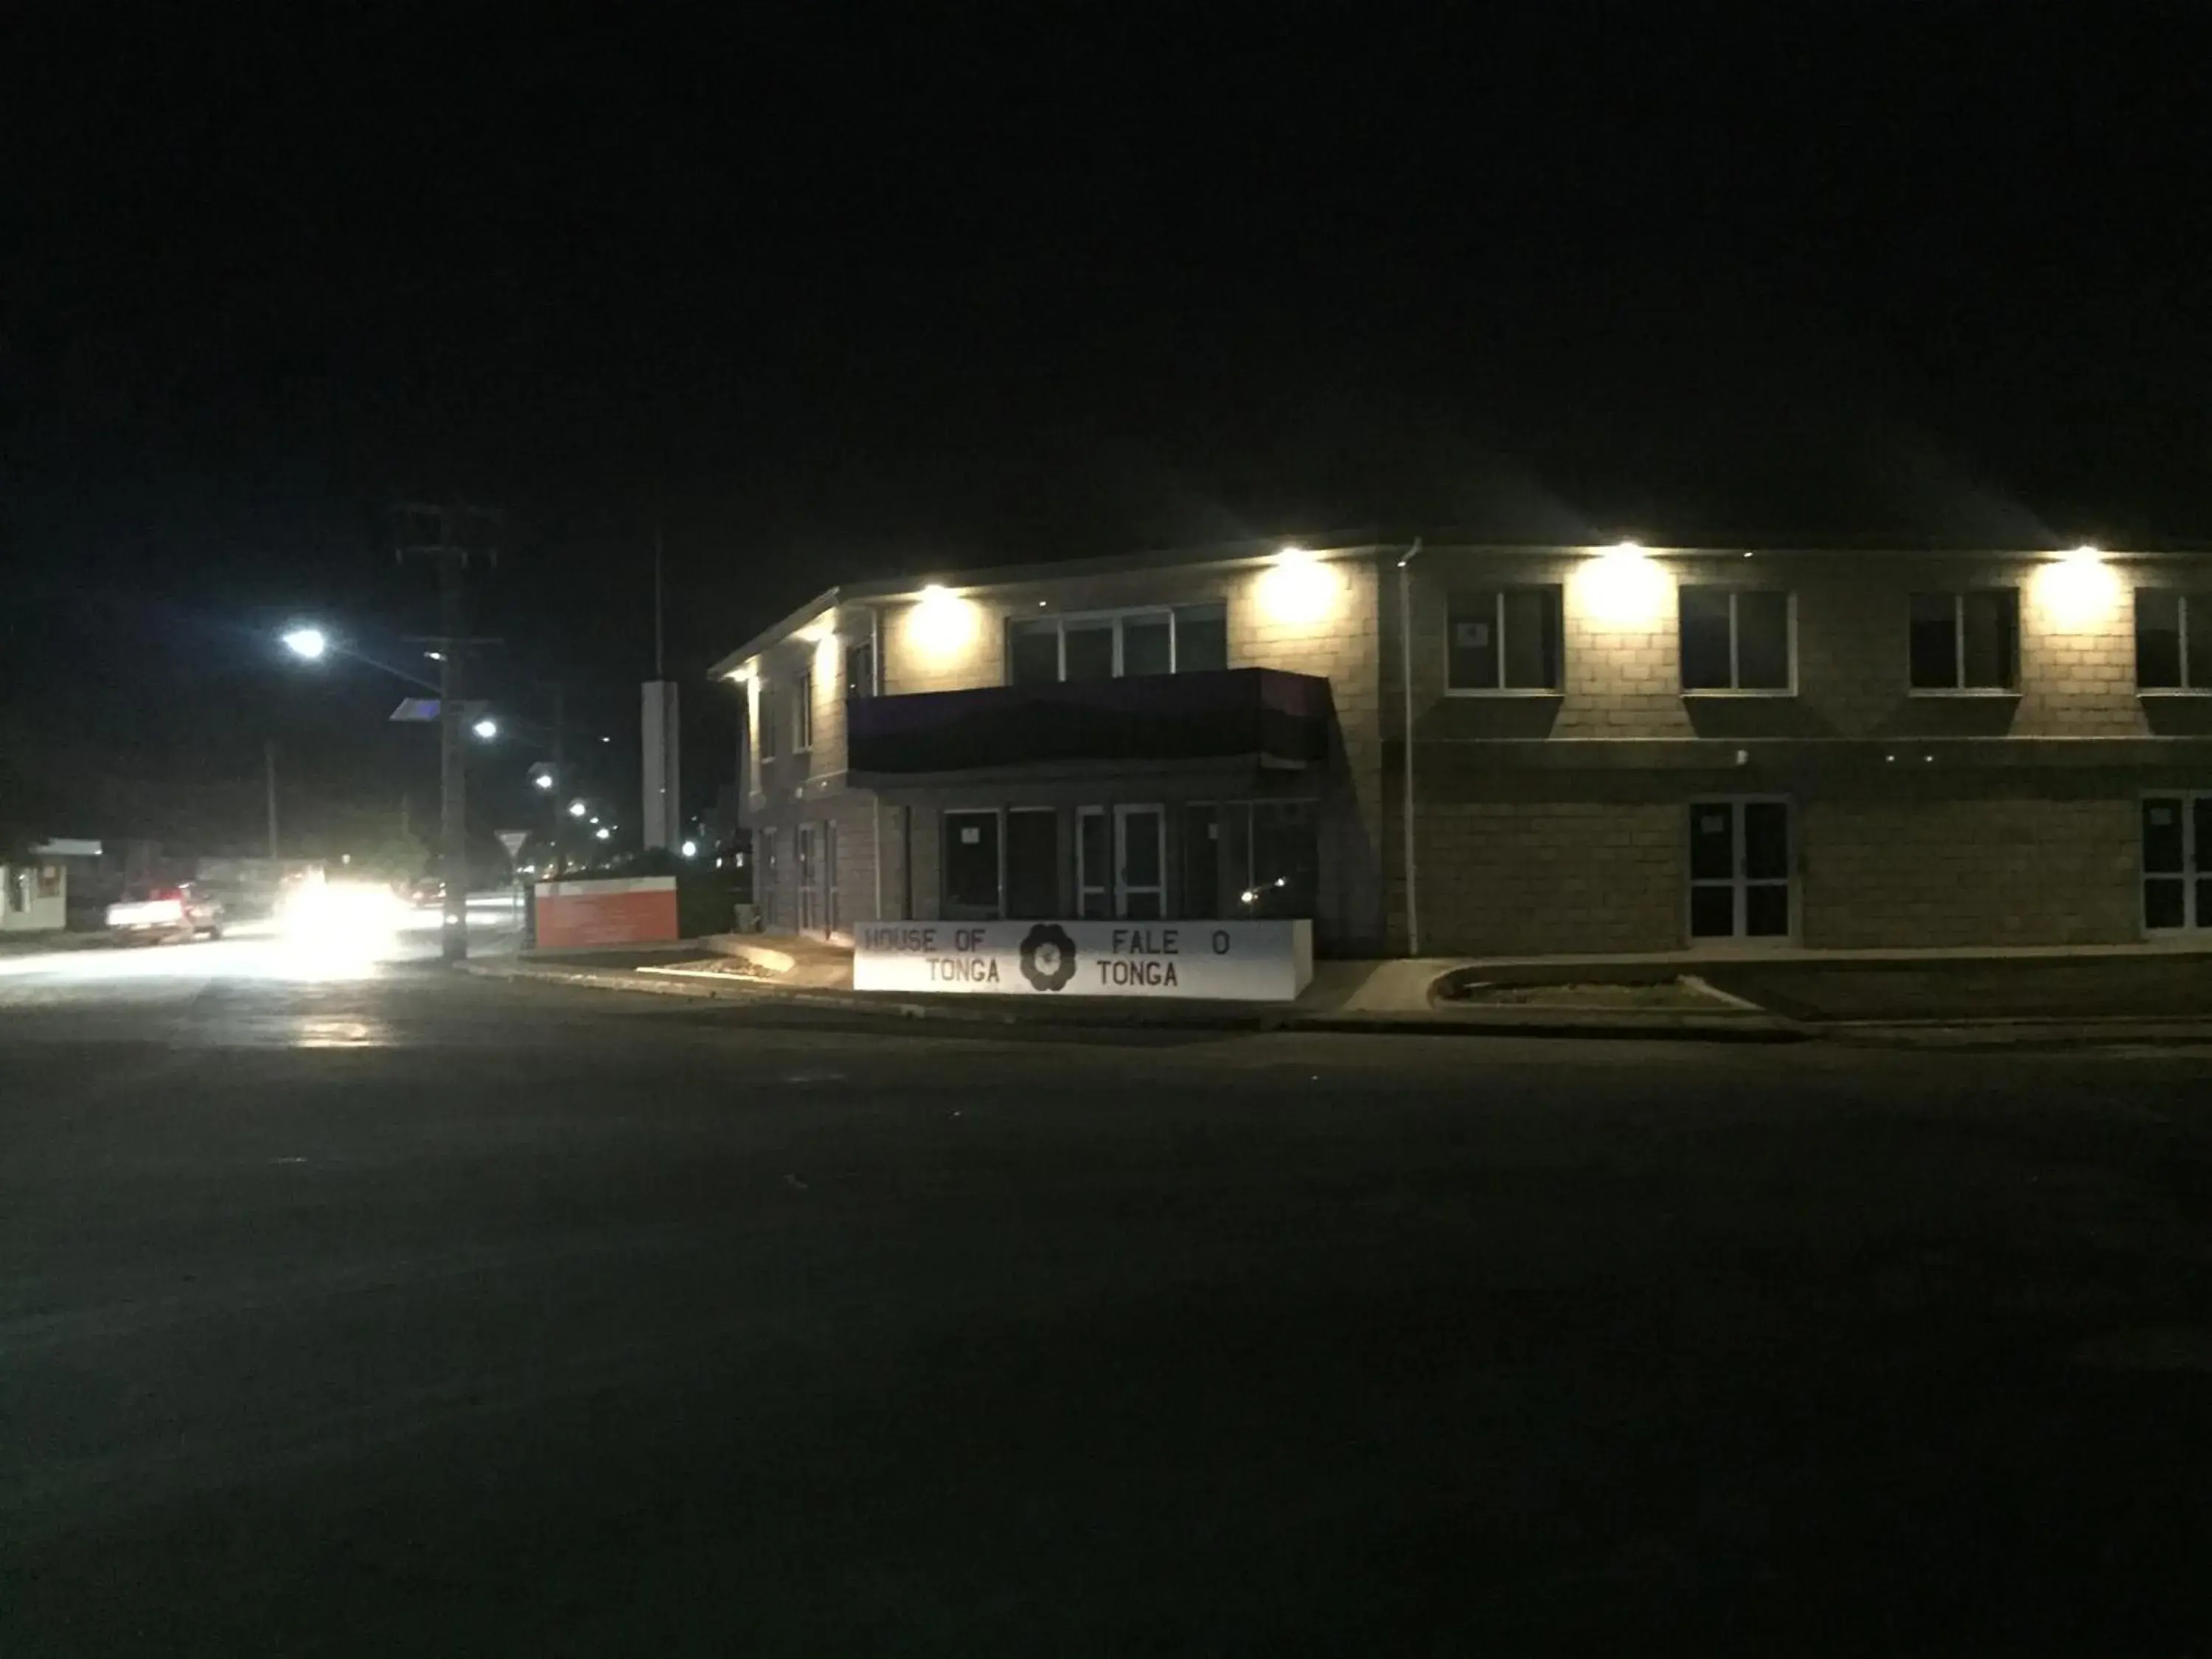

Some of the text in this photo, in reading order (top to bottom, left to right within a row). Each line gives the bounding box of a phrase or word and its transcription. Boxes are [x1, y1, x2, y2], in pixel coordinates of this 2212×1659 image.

[864, 928, 985, 952] HOUSE OF
[1112, 930, 1230, 955] FALE O
[926, 958, 1000, 982] TONGA
[1097, 960, 1178, 987] TONGA
